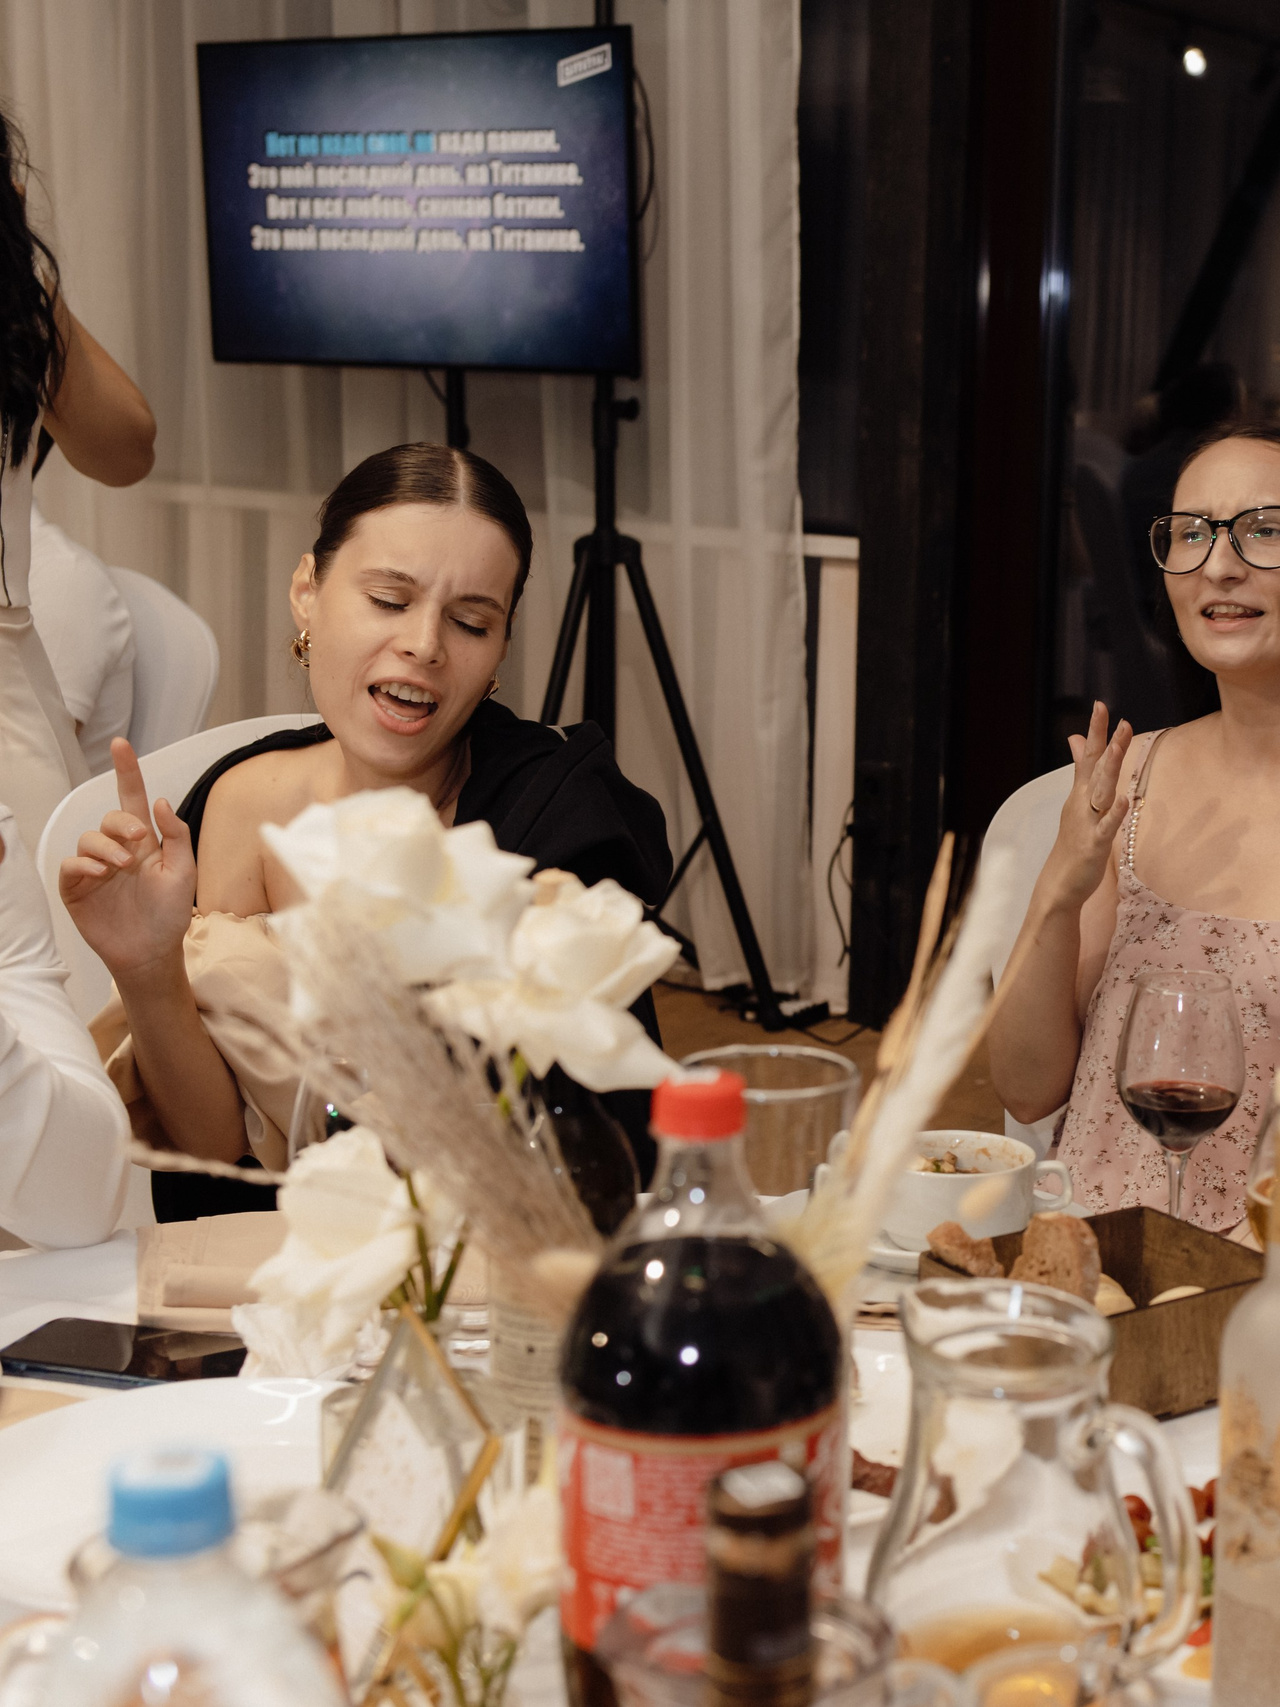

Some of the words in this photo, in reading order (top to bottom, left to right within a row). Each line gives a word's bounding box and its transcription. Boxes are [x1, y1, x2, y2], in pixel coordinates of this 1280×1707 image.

[321, 133, 364, 157] надо
[414, 131, 437, 153] не
[438, 131, 484, 156] надо
[487, 130, 560, 153] паники.
[248, 163, 278, 189] Это
[280, 161, 314, 188] мой
[316, 161, 413, 190] последний
[465, 163, 490, 186] на
[490, 159, 584, 186] Титанике.
[298, 197, 311, 219] и
[312, 197, 343, 220] вся
[251, 224, 281, 251] Это
[282, 224, 317, 251] мой
[319, 224, 415, 254] последний
[467, 228, 492, 252] на
[491, 225, 585, 252] Титанике.
